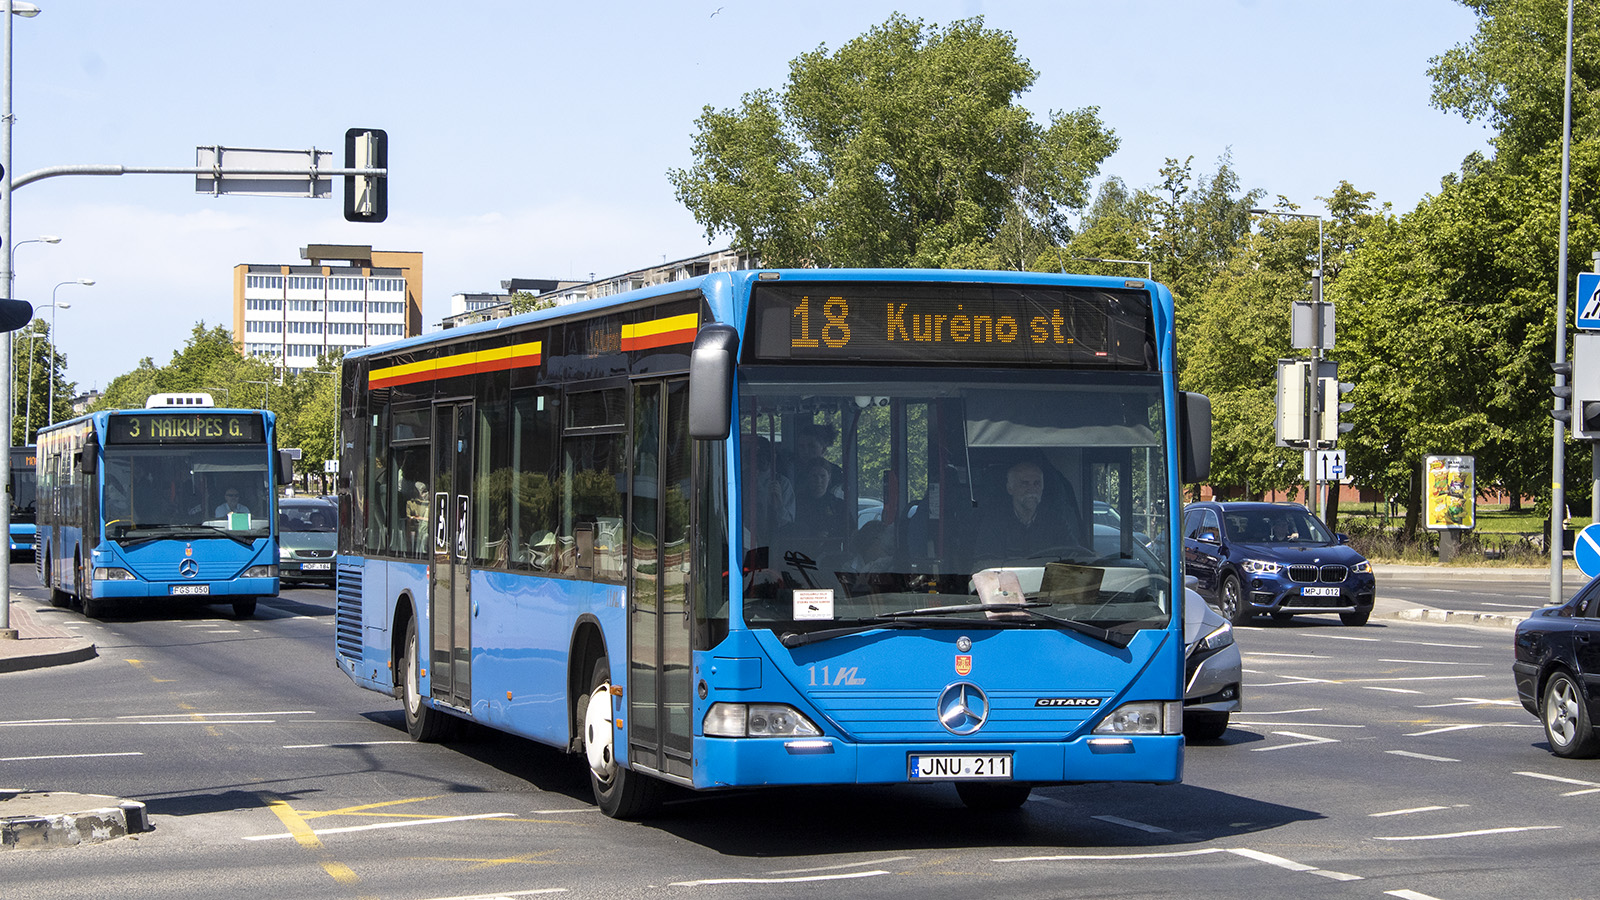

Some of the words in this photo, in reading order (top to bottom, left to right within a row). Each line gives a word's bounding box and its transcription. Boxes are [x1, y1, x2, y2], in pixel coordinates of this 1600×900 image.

[791, 295, 851, 348] 18
[886, 303, 1018, 343] Kurėno
[1030, 308, 1075, 344] st.
[129, 418, 140, 437] 3
[151, 417, 223, 437] NAIKUPĖS
[229, 418, 243, 437] G.
[174, 586, 190, 594] FGS
[194, 586, 208, 594] 050
[1305, 588, 1322, 596] MPJ
[1325, 588, 1339, 596] 012
[808, 665, 831, 686] 11
[1037, 698, 1100, 706] CITARO
[922, 757, 962, 775] JNU
[974, 757, 1006, 775] 211
